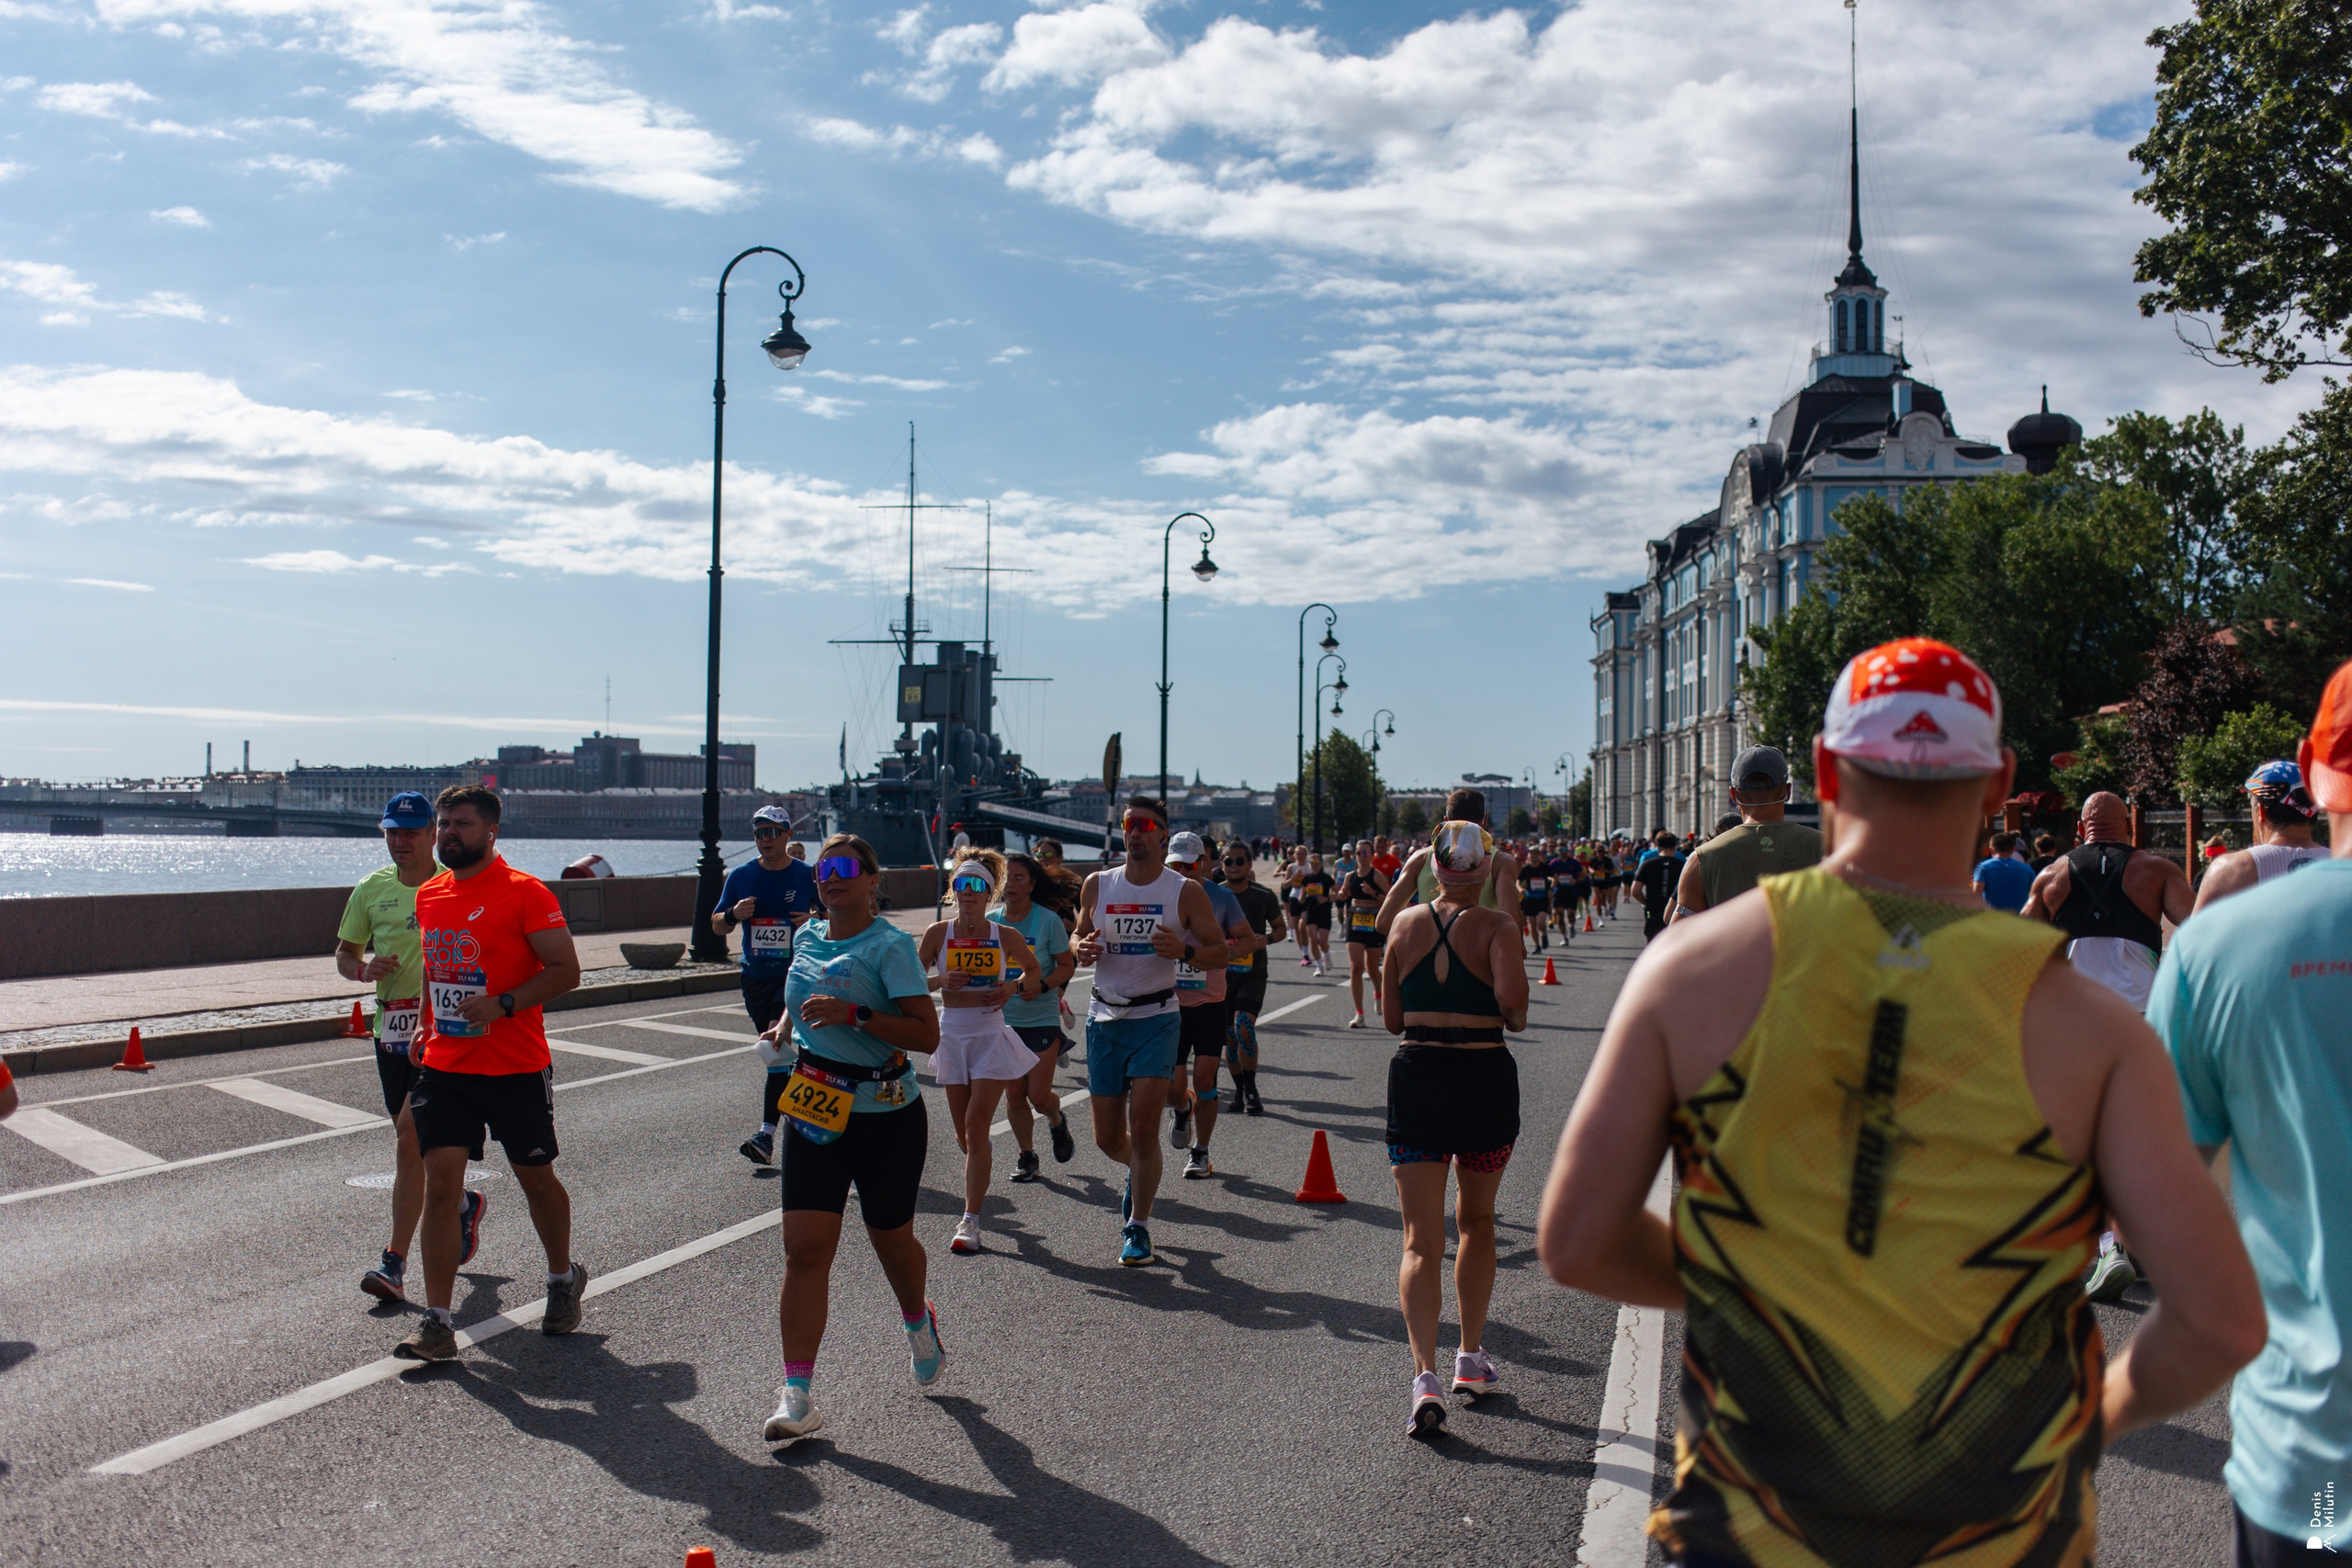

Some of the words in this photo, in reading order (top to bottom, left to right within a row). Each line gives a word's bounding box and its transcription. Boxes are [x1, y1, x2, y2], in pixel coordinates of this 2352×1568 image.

[1114, 918, 1156, 934] 1737
[425, 929, 470, 946] МОС
[755, 929, 786, 942] 4432
[425, 947, 464, 964] КОВ
[955, 952, 994, 967] 1753
[2290, 959, 2352, 979] ВРЕМ
[1864, 997, 1907, 1097] TEAM
[825, 1075, 836, 1084] 21,1
[836, 1078, 848, 1088] КМ
[789, 1082, 841, 1118] 4924
[791, 1105, 830, 1125] АНАСТАСИЯ
